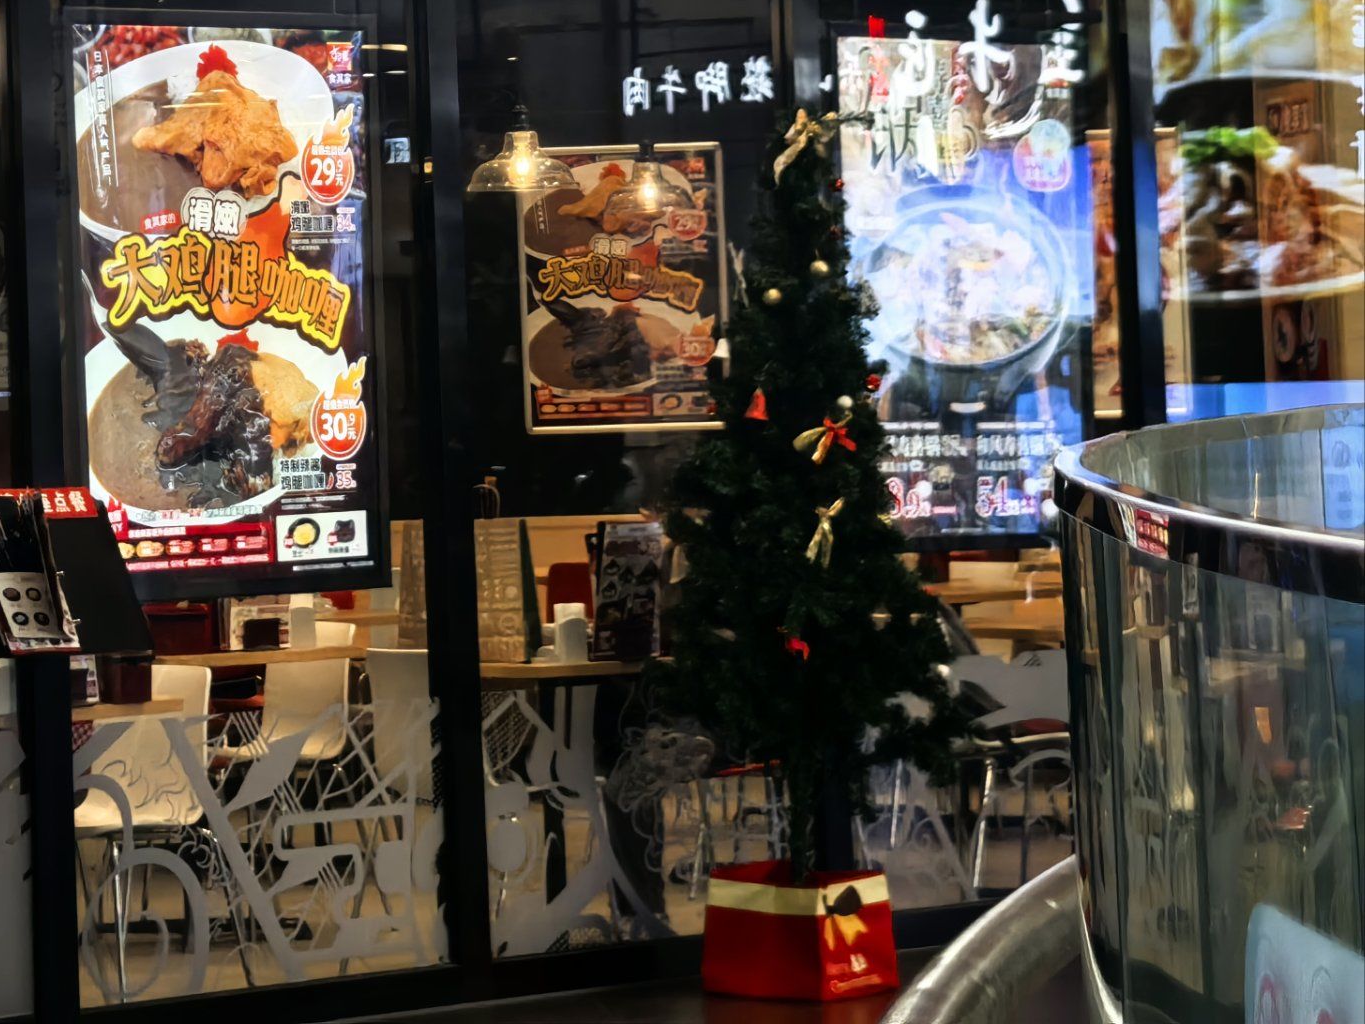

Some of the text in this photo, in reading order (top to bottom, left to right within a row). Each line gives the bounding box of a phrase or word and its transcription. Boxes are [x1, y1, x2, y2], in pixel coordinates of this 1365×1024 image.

[108, 236, 346, 339] 大鸡腿咖喱
